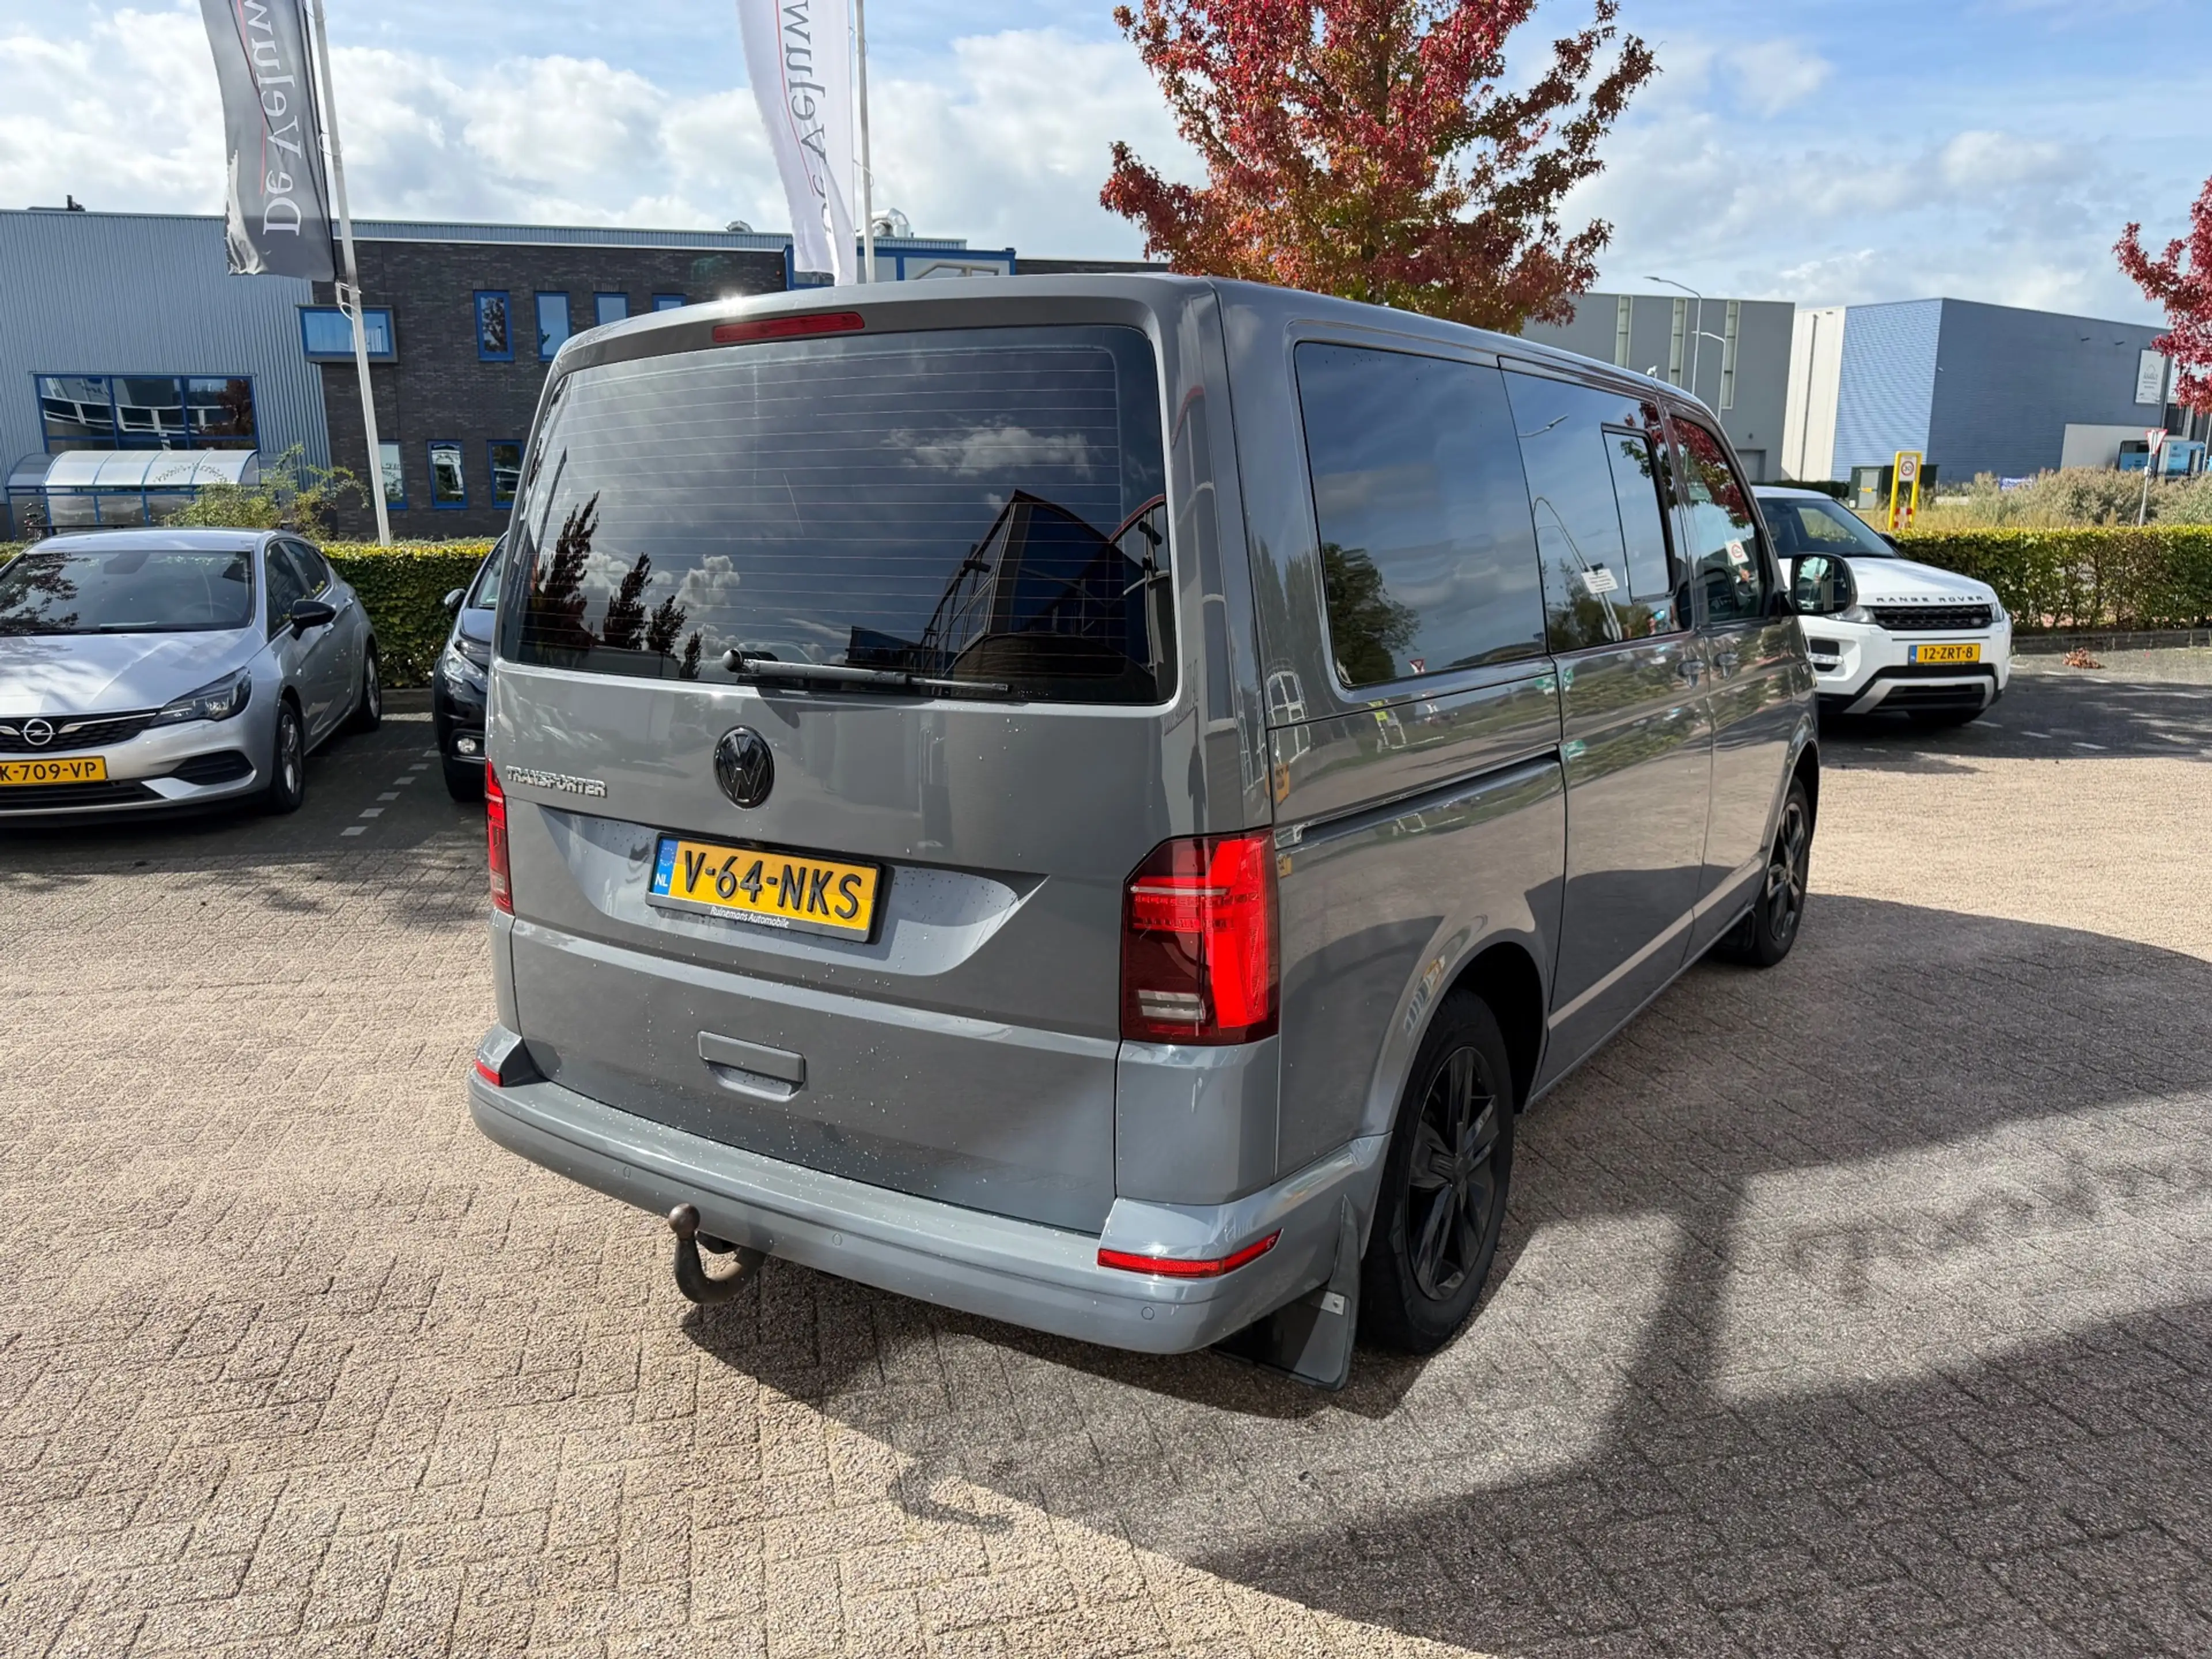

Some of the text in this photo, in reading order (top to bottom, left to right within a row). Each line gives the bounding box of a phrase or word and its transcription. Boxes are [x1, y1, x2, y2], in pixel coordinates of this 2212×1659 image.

[0, 762, 97, 781] K-709-VP
[506, 765, 608, 798] TRANSPORTER
[655, 873, 668, 887] NL
[684, 850, 862, 919] V-64-NKS
